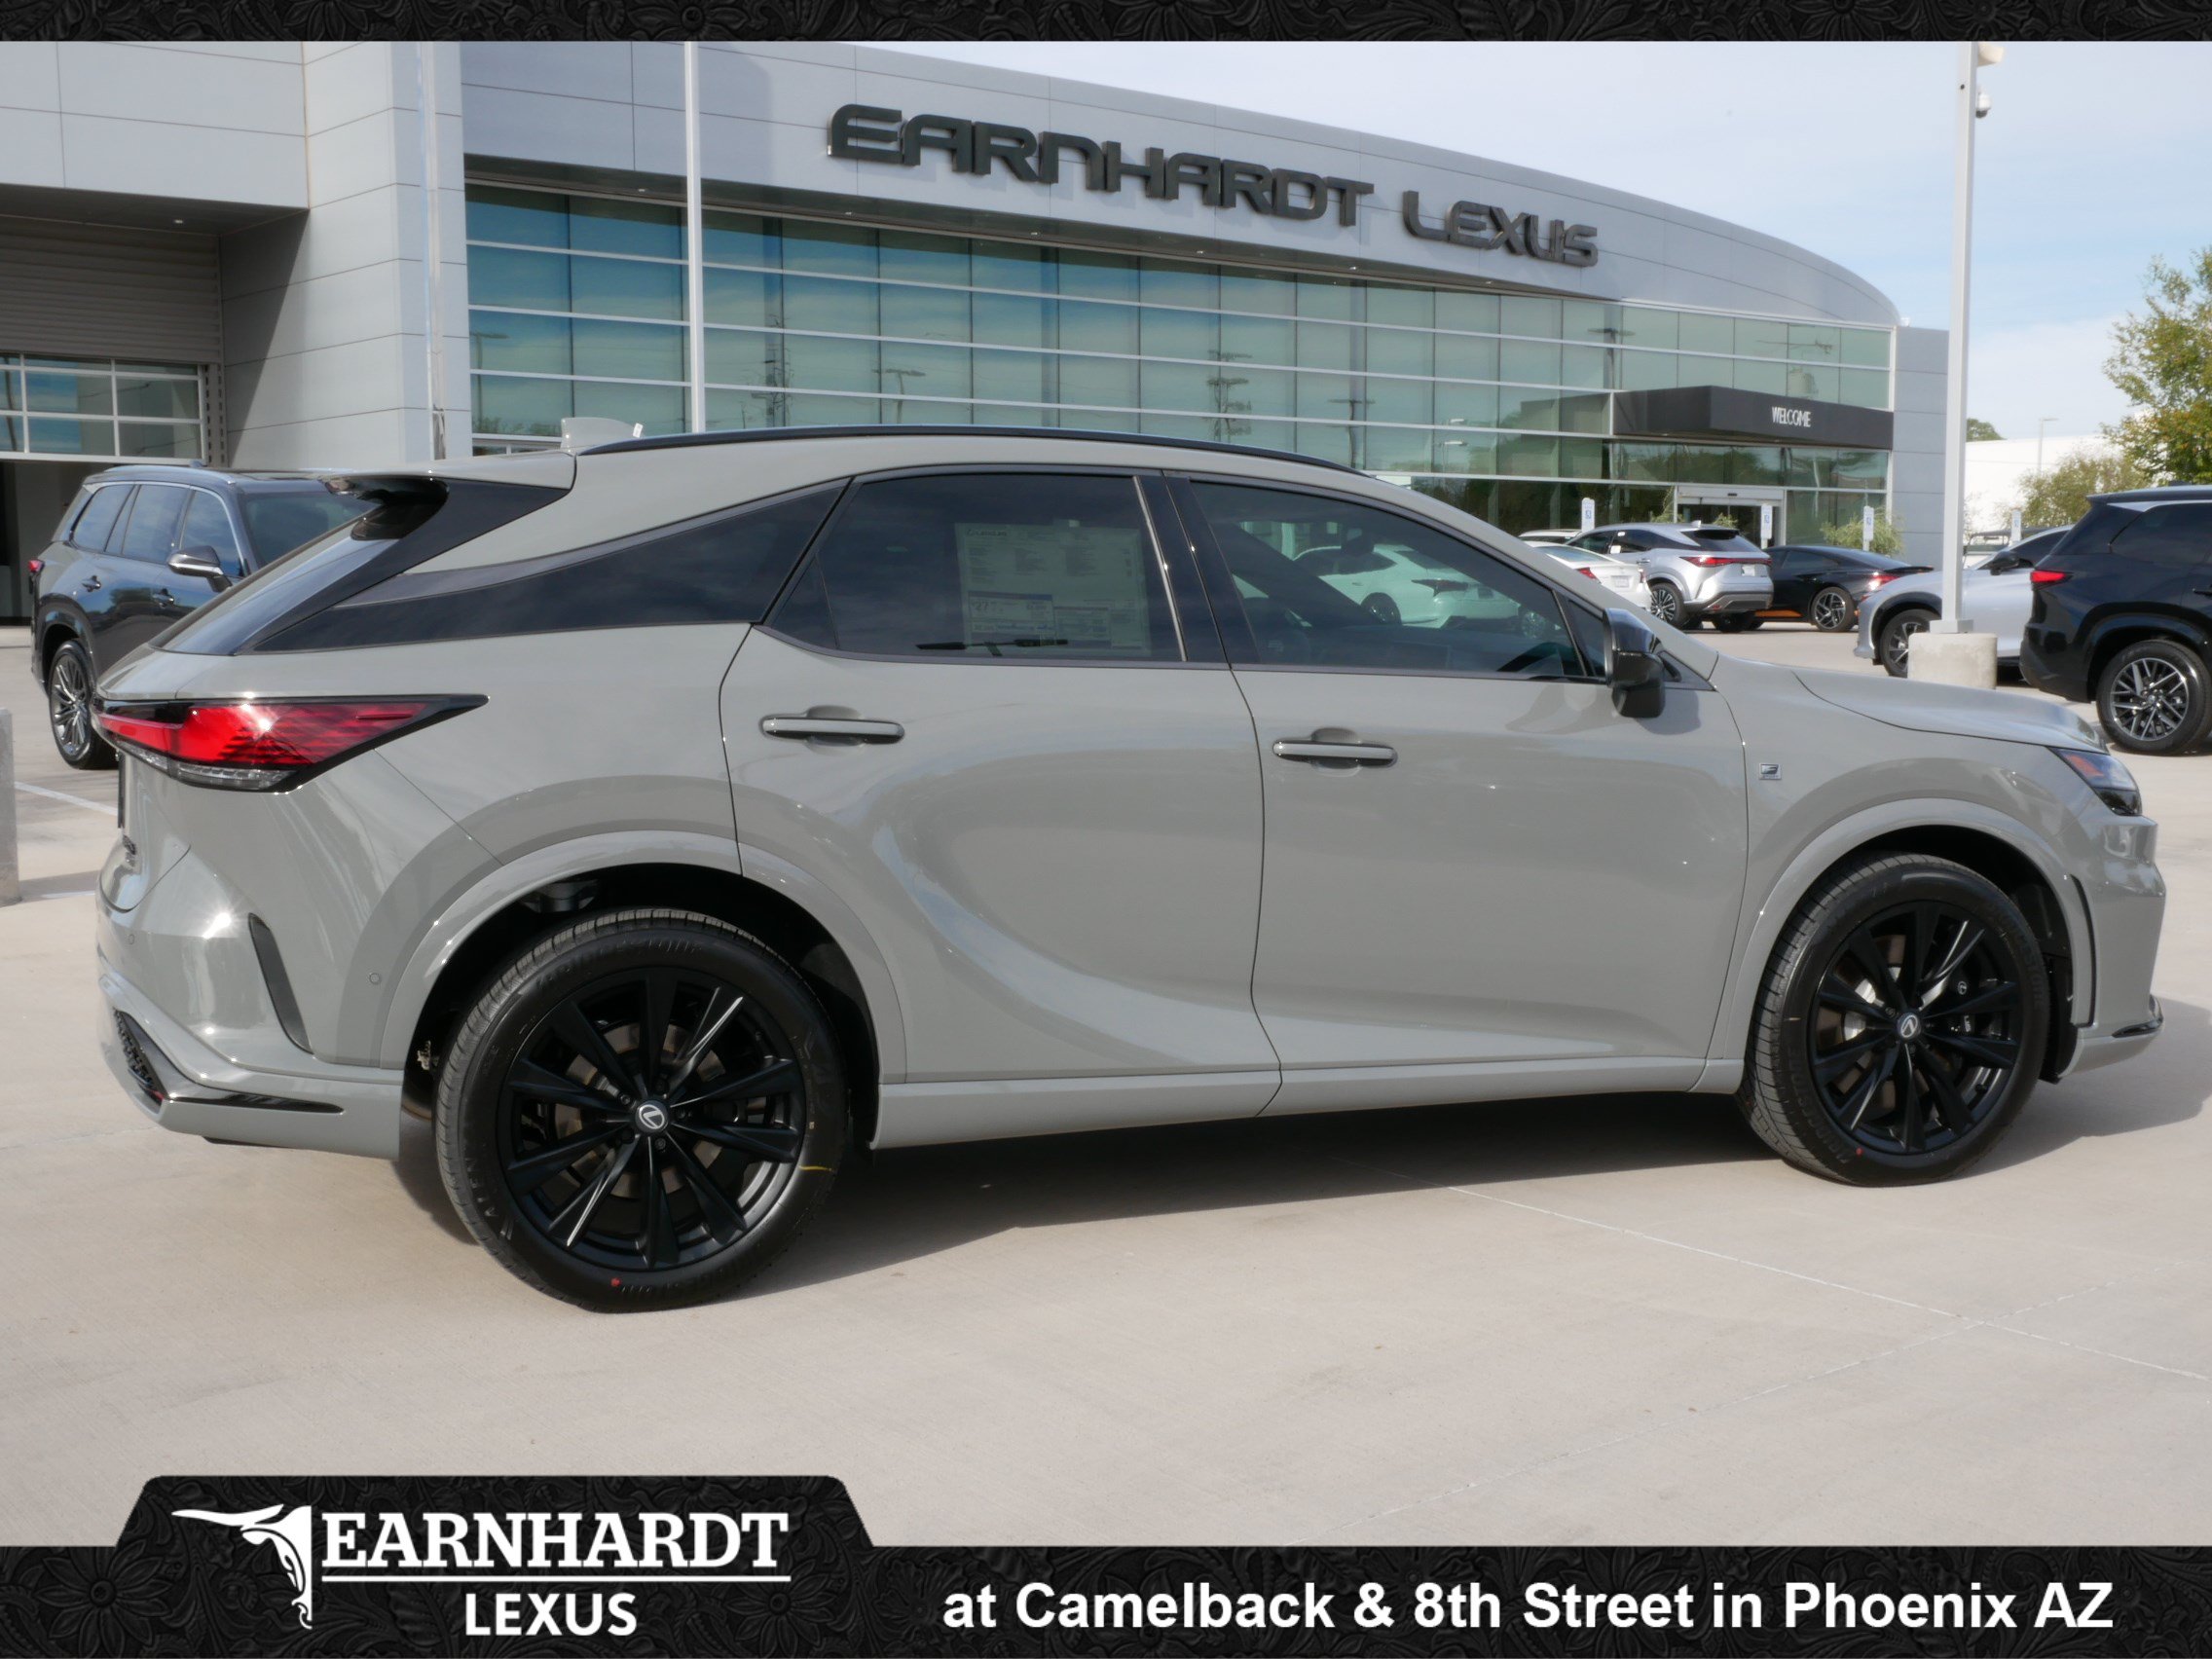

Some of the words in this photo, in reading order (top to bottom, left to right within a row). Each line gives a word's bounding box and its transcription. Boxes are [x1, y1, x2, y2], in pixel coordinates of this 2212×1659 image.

[827, 104, 1374, 226] EARNHARDT
[1403, 191, 1598, 267] LEXUS
[1772, 406, 1811, 427] WELCOME
